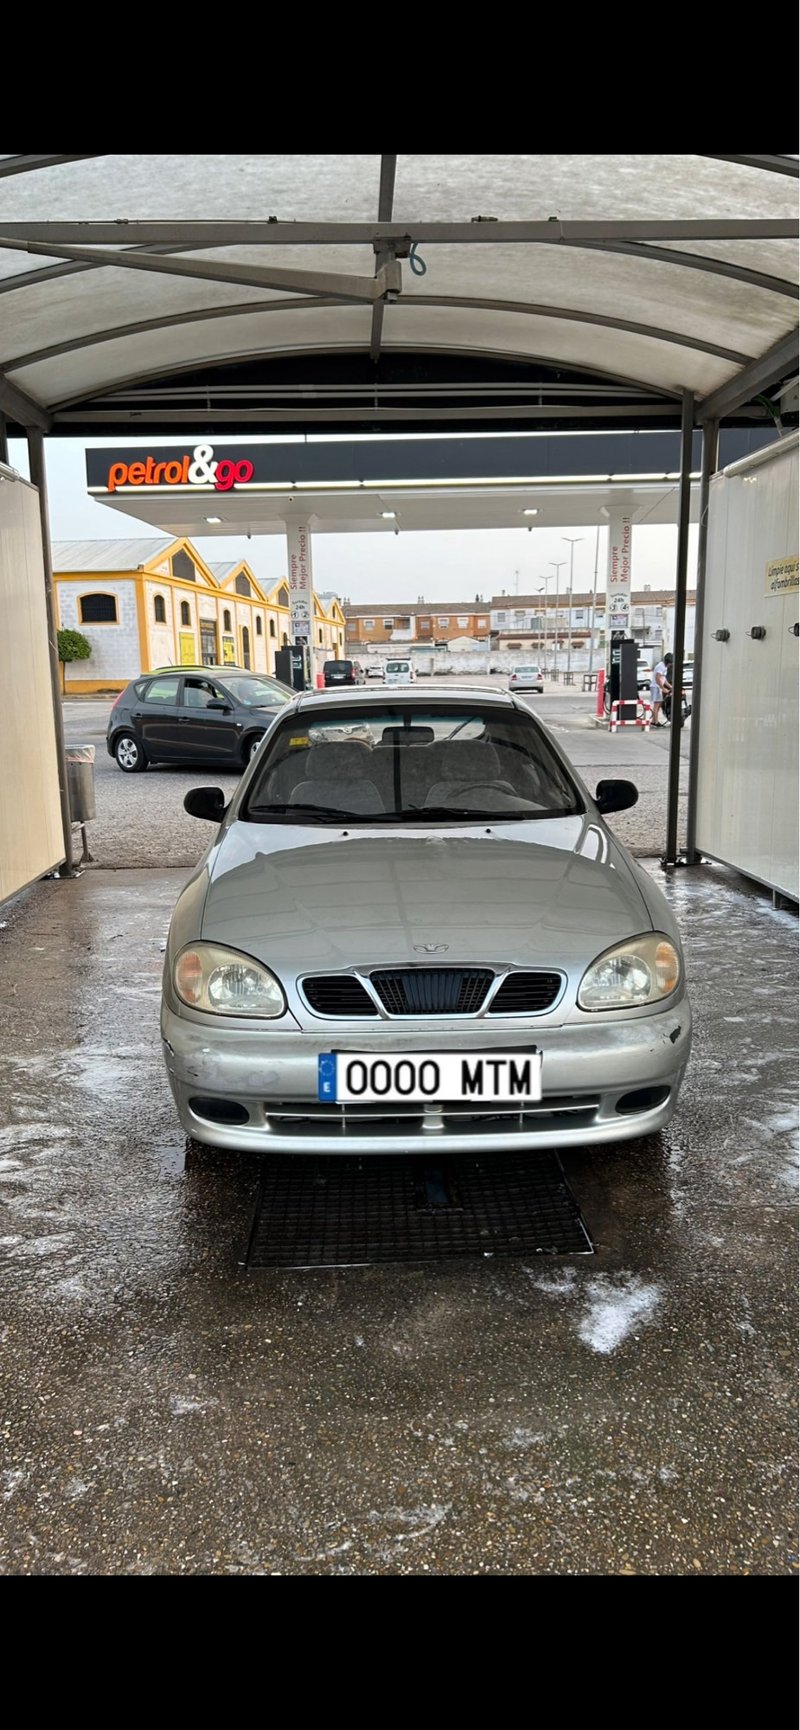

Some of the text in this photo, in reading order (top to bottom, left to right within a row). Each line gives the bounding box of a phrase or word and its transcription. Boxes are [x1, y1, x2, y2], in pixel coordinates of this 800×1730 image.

[108, 444, 254, 492] petrol&go
[621, 526, 629, 553] Precio
[290, 554, 298, 590] Siempre
[299, 564, 308, 590] Mejor
[610, 546, 619, 583] Siempre
[620, 556, 630, 583] Mejor
[323, 1082, 331, 1092] E
[346, 1060, 532, 1096] 0000 MTM
